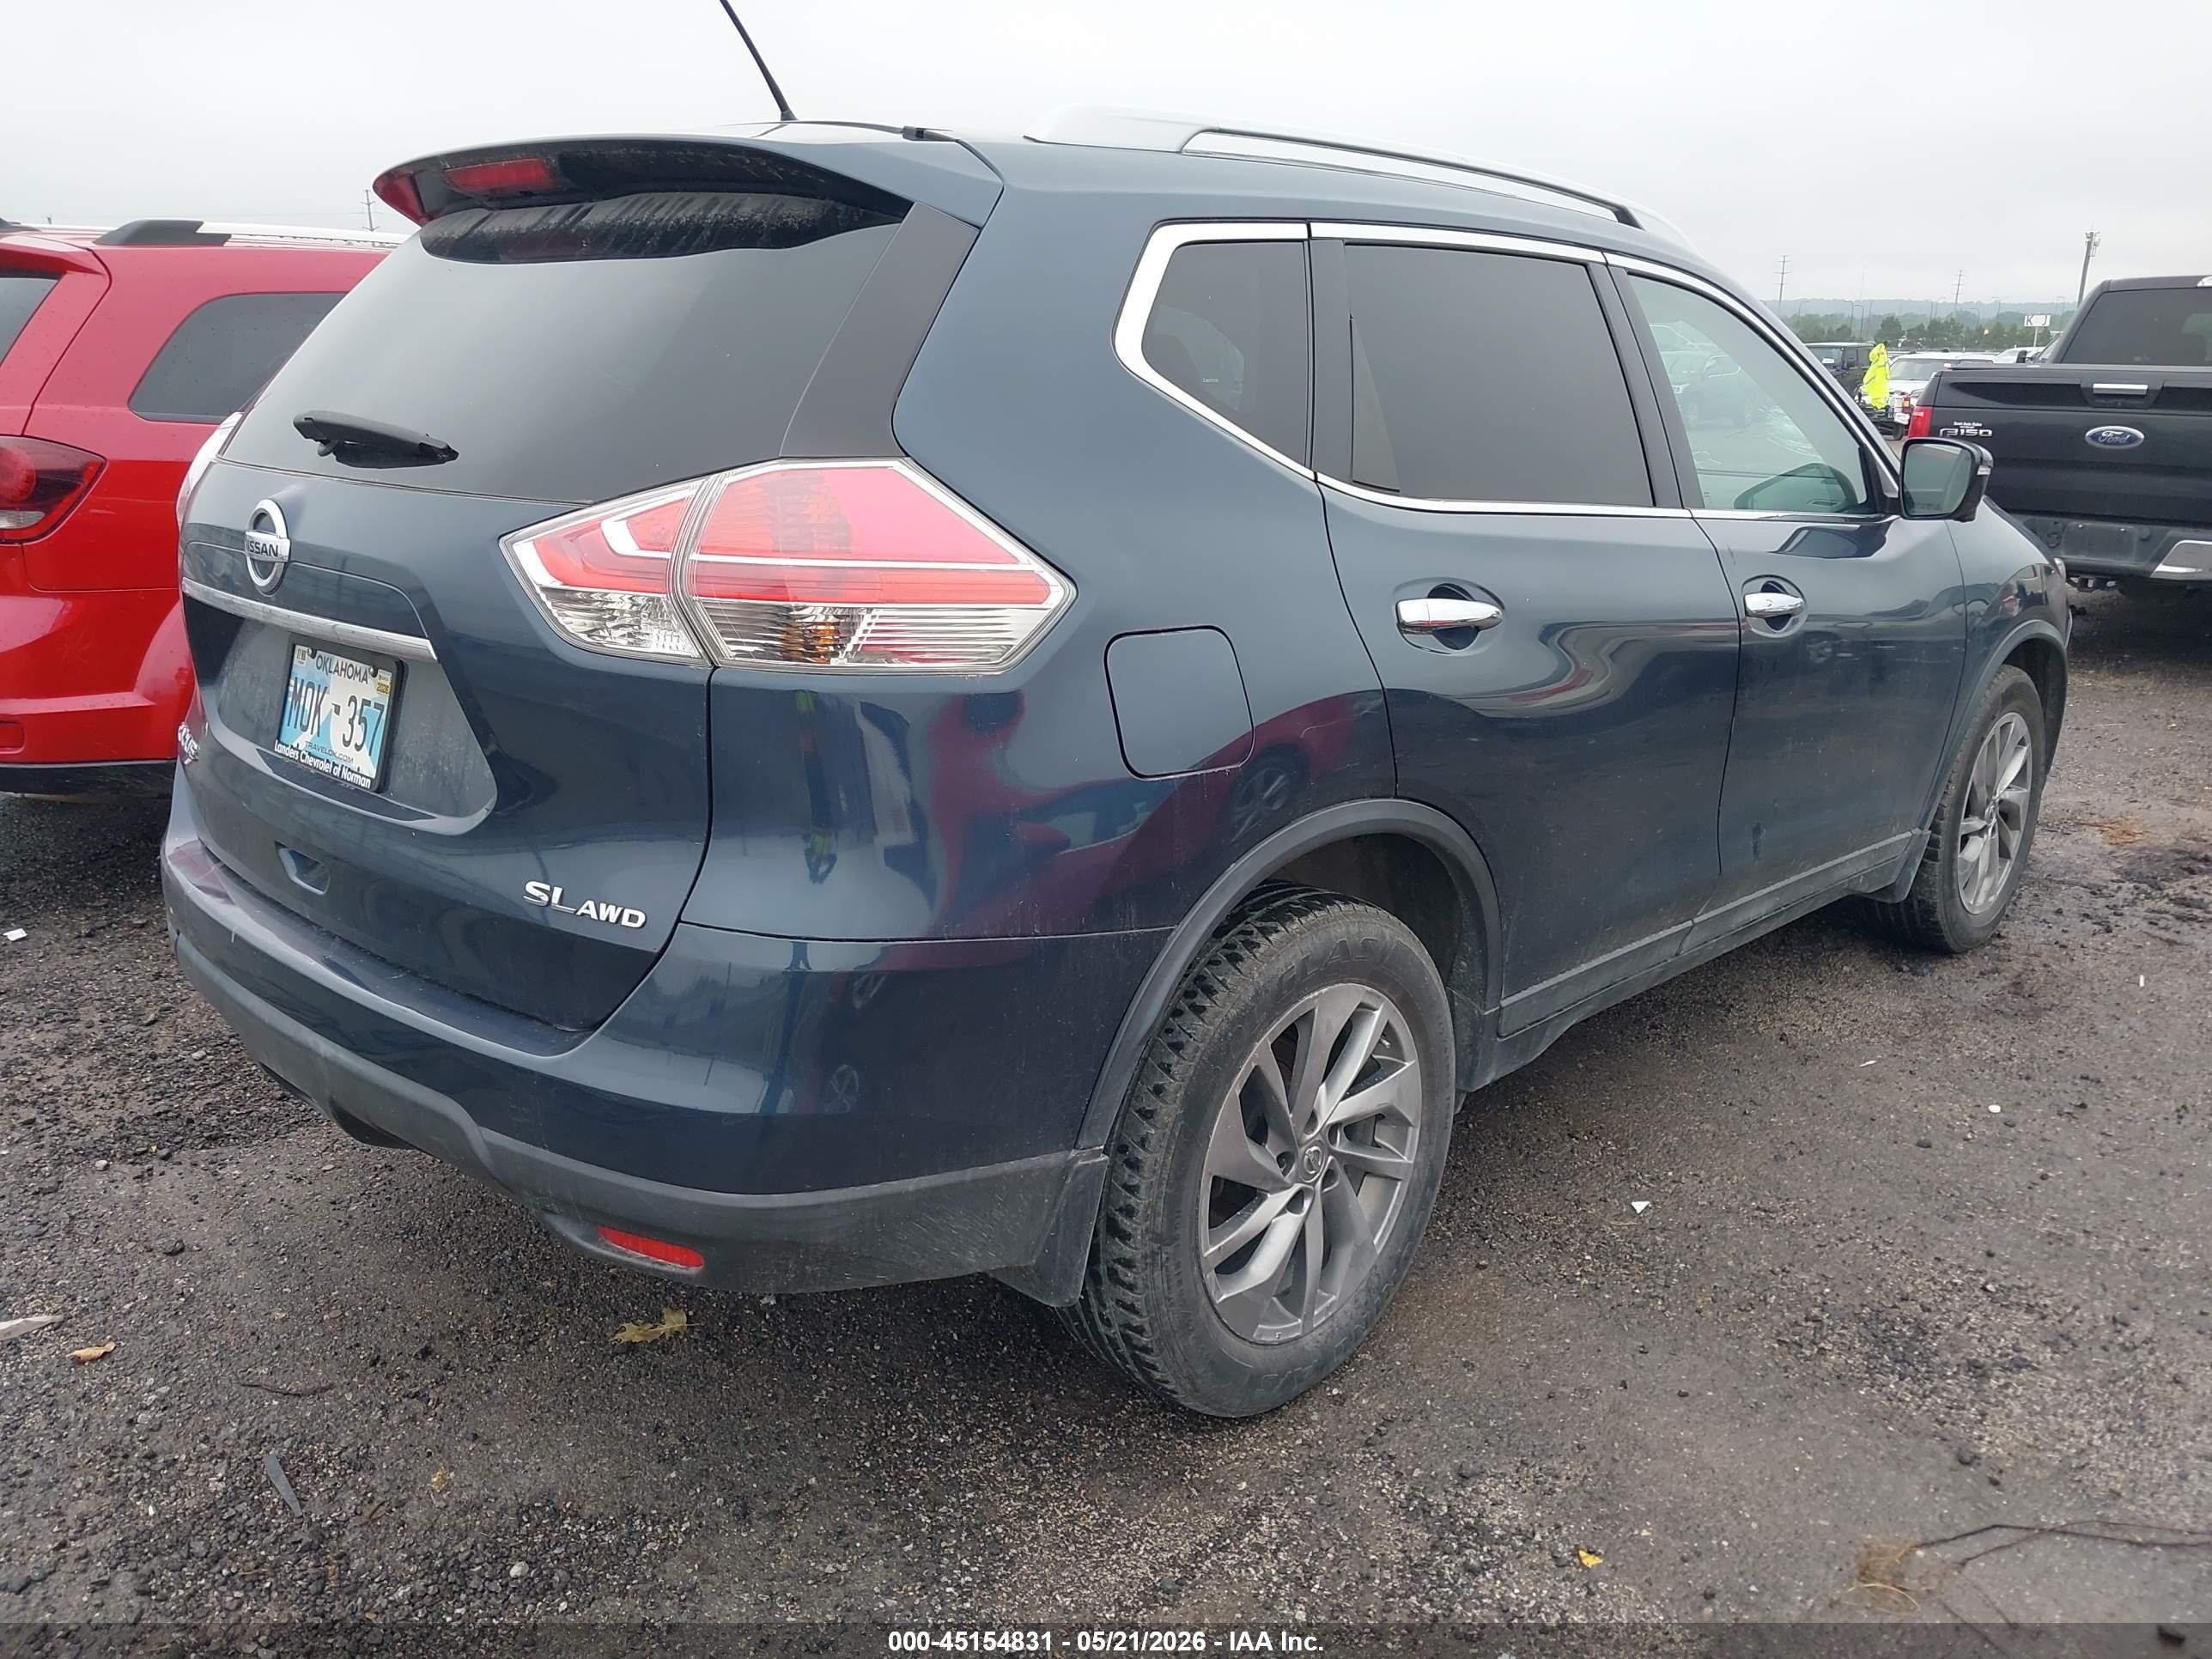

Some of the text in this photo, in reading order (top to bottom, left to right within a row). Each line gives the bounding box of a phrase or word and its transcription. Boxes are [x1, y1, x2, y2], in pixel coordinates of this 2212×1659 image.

[2099, 430, 2130, 443] Ford
[316, 655, 369, 684] OKLAHOMA
[275, 739, 371, 788] Landers Chevrolet of Norman
[305, 741, 354, 763] TRAVELOK.COM
